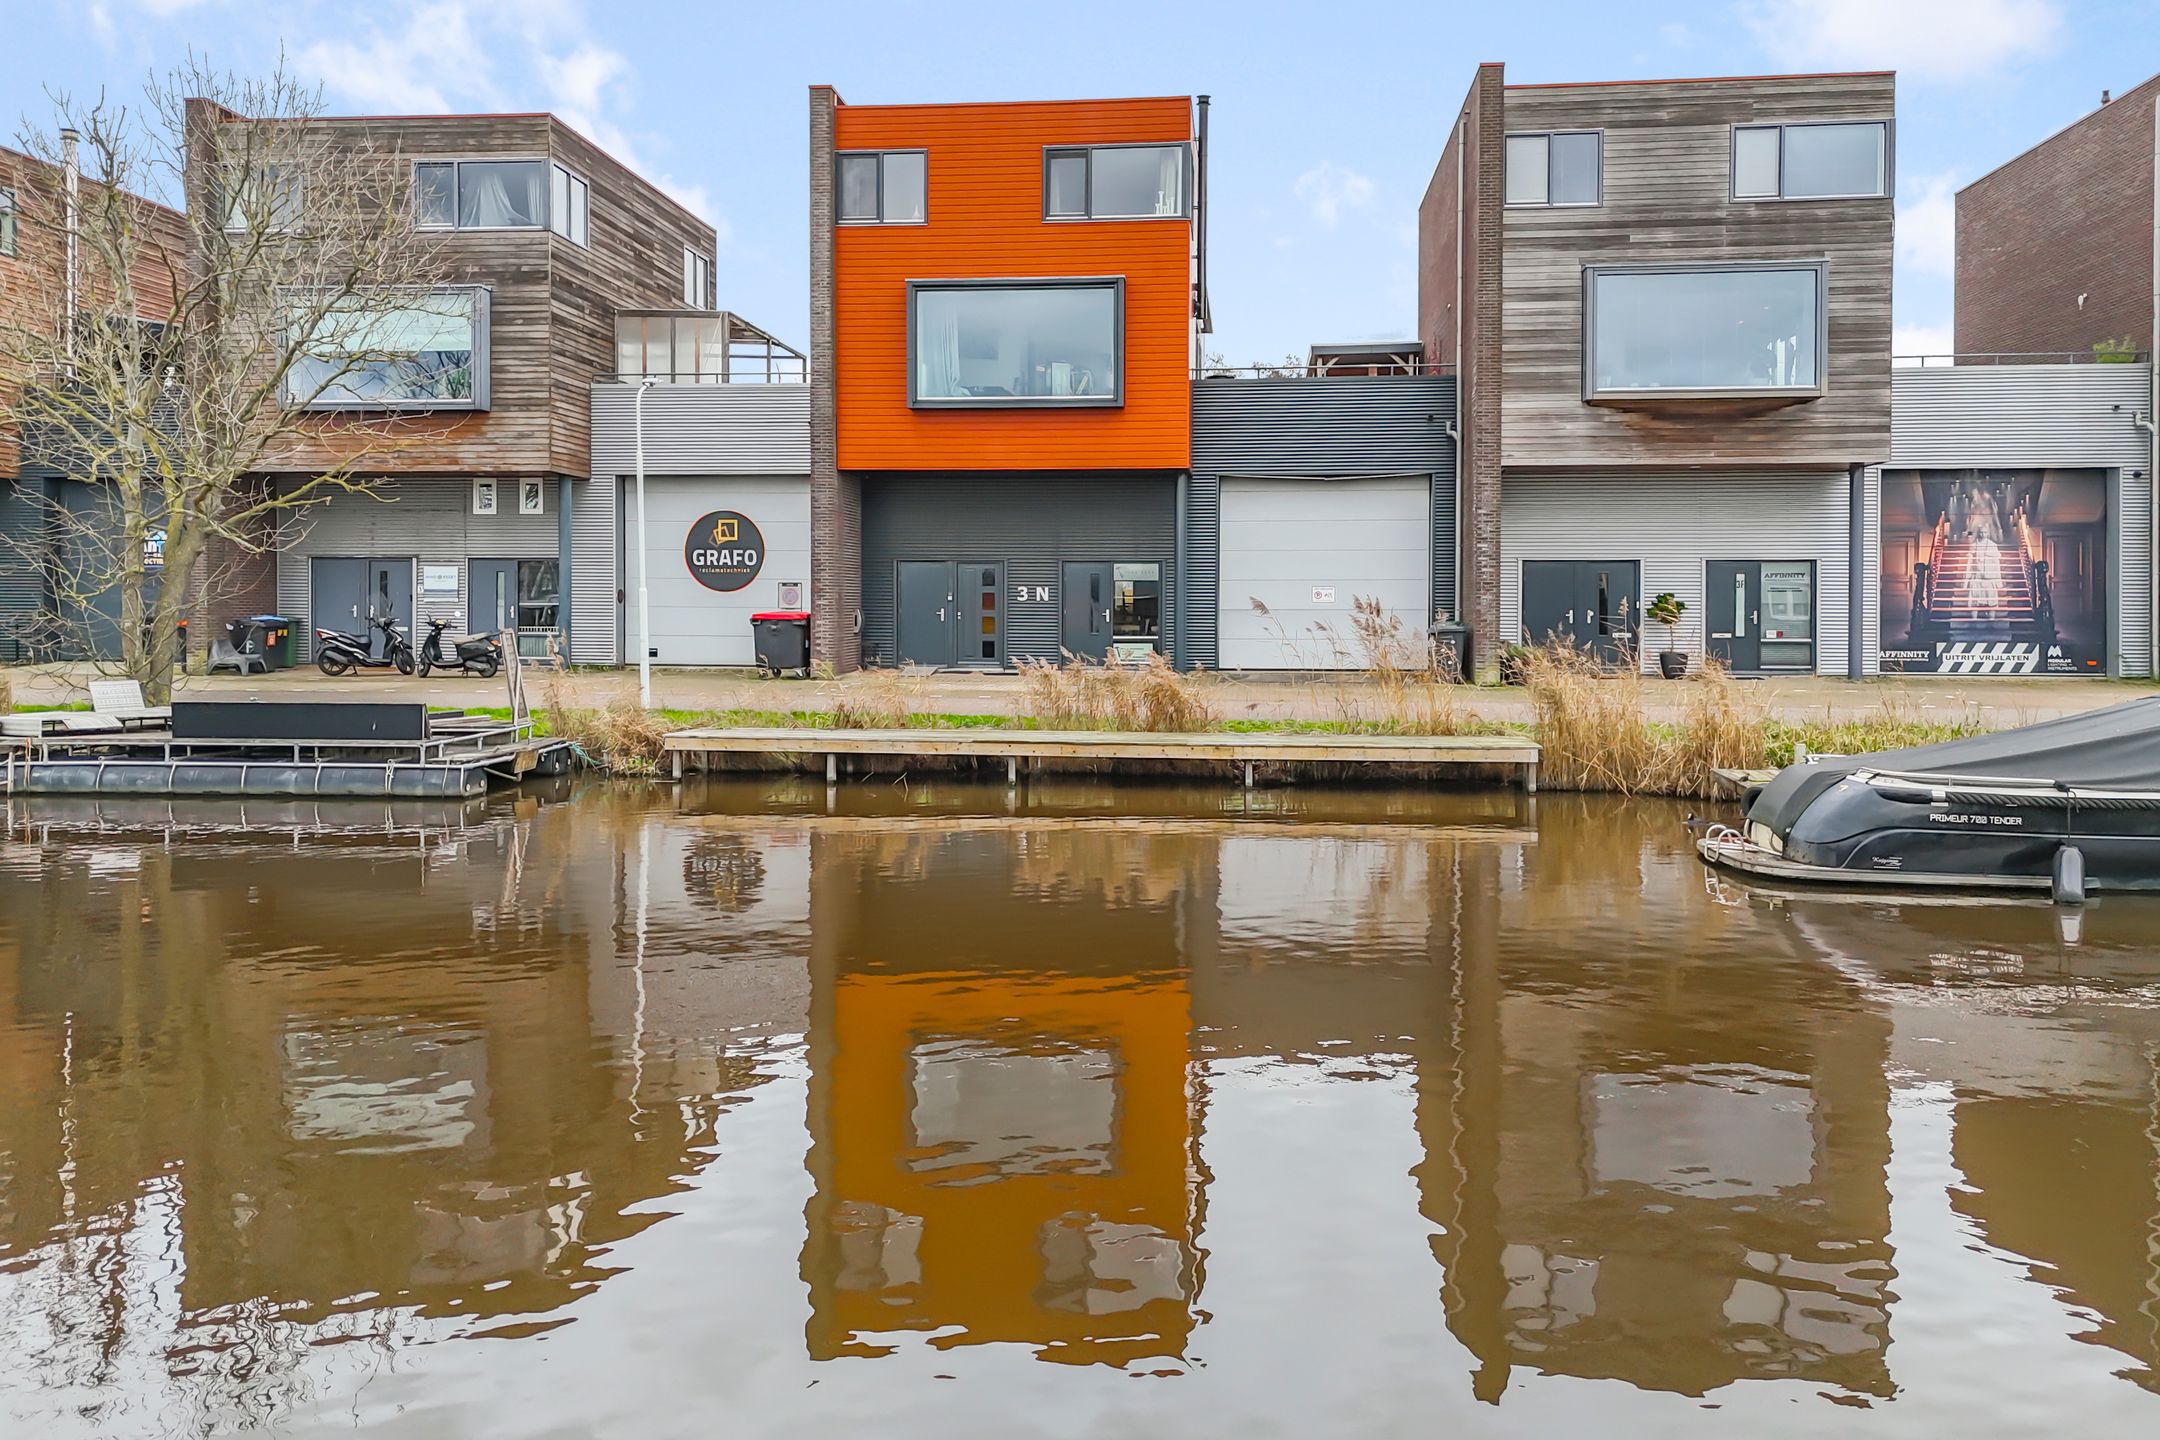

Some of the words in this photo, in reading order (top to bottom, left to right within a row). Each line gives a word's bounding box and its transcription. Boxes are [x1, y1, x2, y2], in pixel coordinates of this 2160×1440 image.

[692, 549, 757, 566] GRAFO
[1880, 650, 1930, 658] AFFINNITY
[1929, 813, 1969, 823] PRIMEUR
[1969, 815, 1988, 824] 700
[1989, 816, 2023, 825] TENDER
